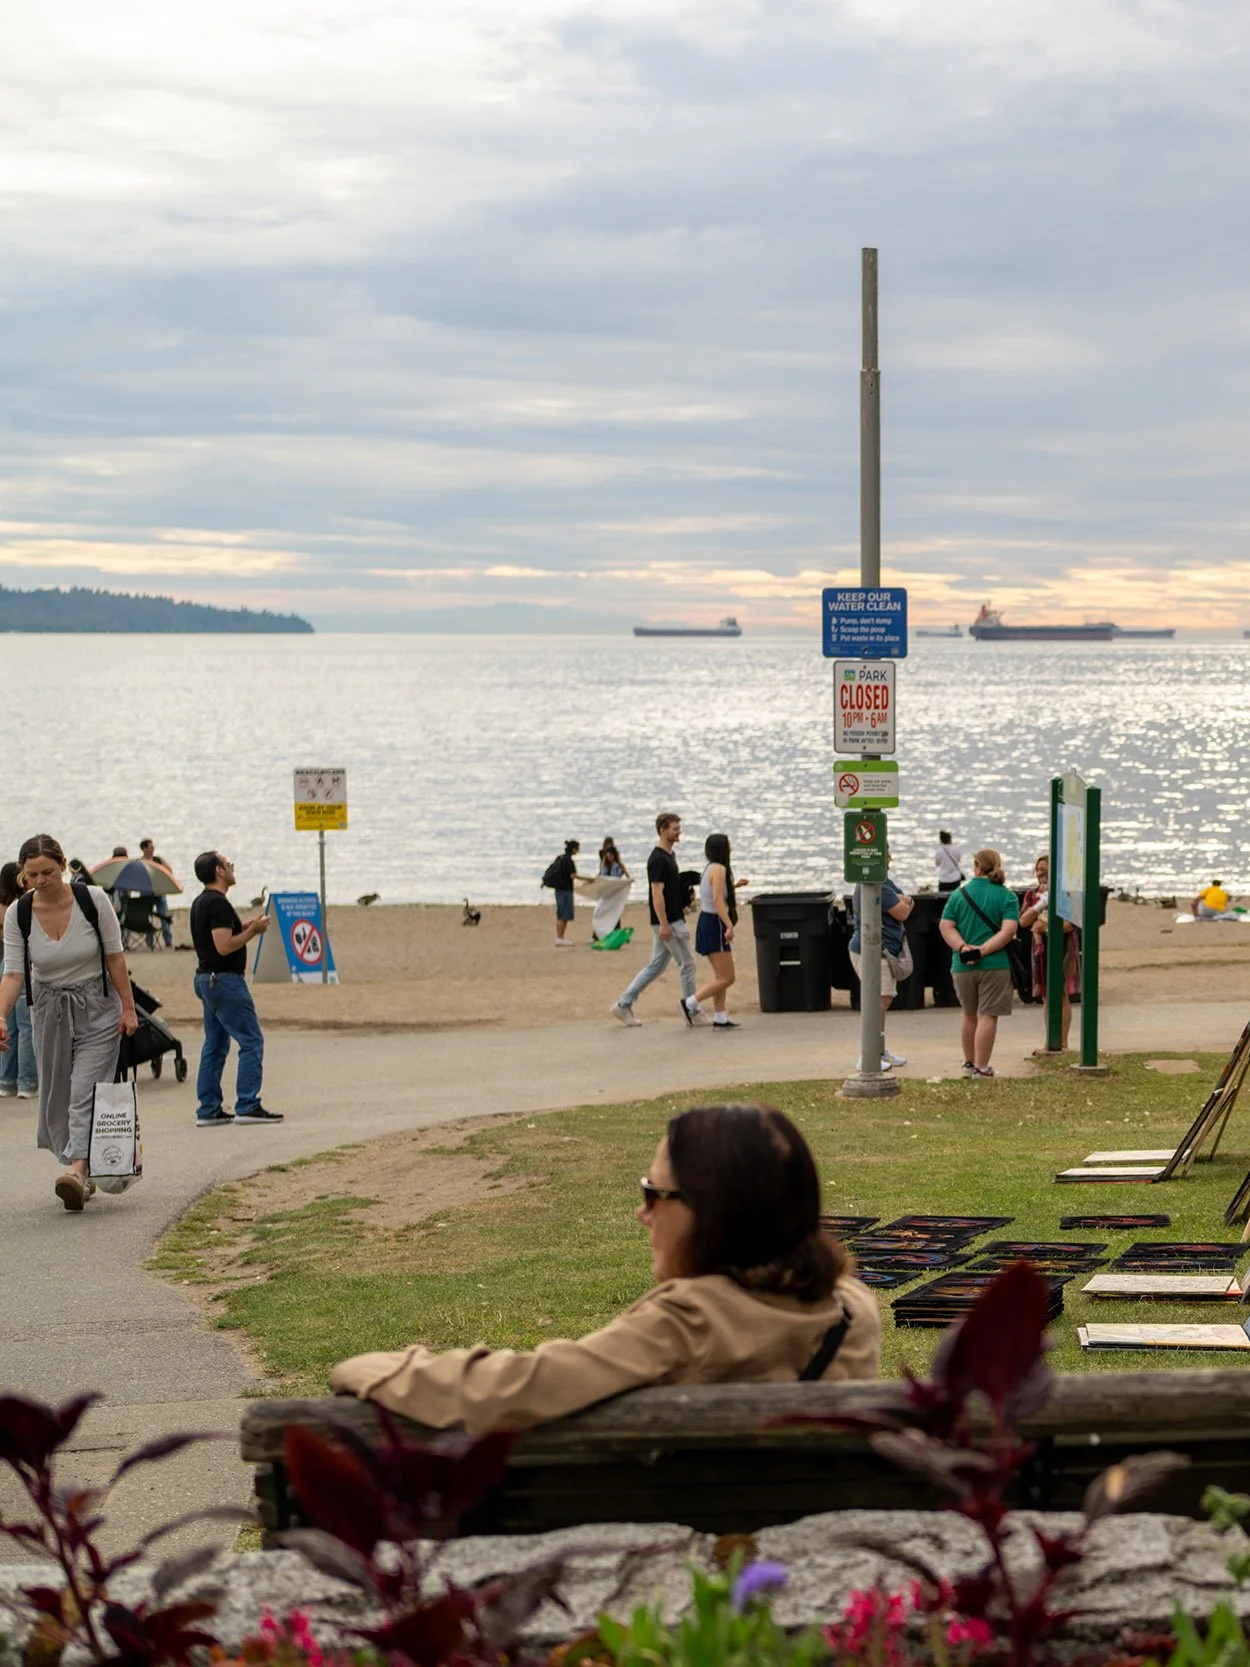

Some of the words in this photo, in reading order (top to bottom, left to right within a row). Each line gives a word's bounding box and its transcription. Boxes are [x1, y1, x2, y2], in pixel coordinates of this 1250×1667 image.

[837, 592, 866, 602] KEEP
[867, 592, 891, 602] OUR
[828, 602, 865, 611] WATER
[866, 602, 901, 611] CLEAN
[884, 634, 900, 642] place
[859, 670, 887, 681] PARK
[840, 684, 889, 710] CLOSED
[842, 712, 863, 728] 10PM
[870, 712, 887, 728] 6AM
